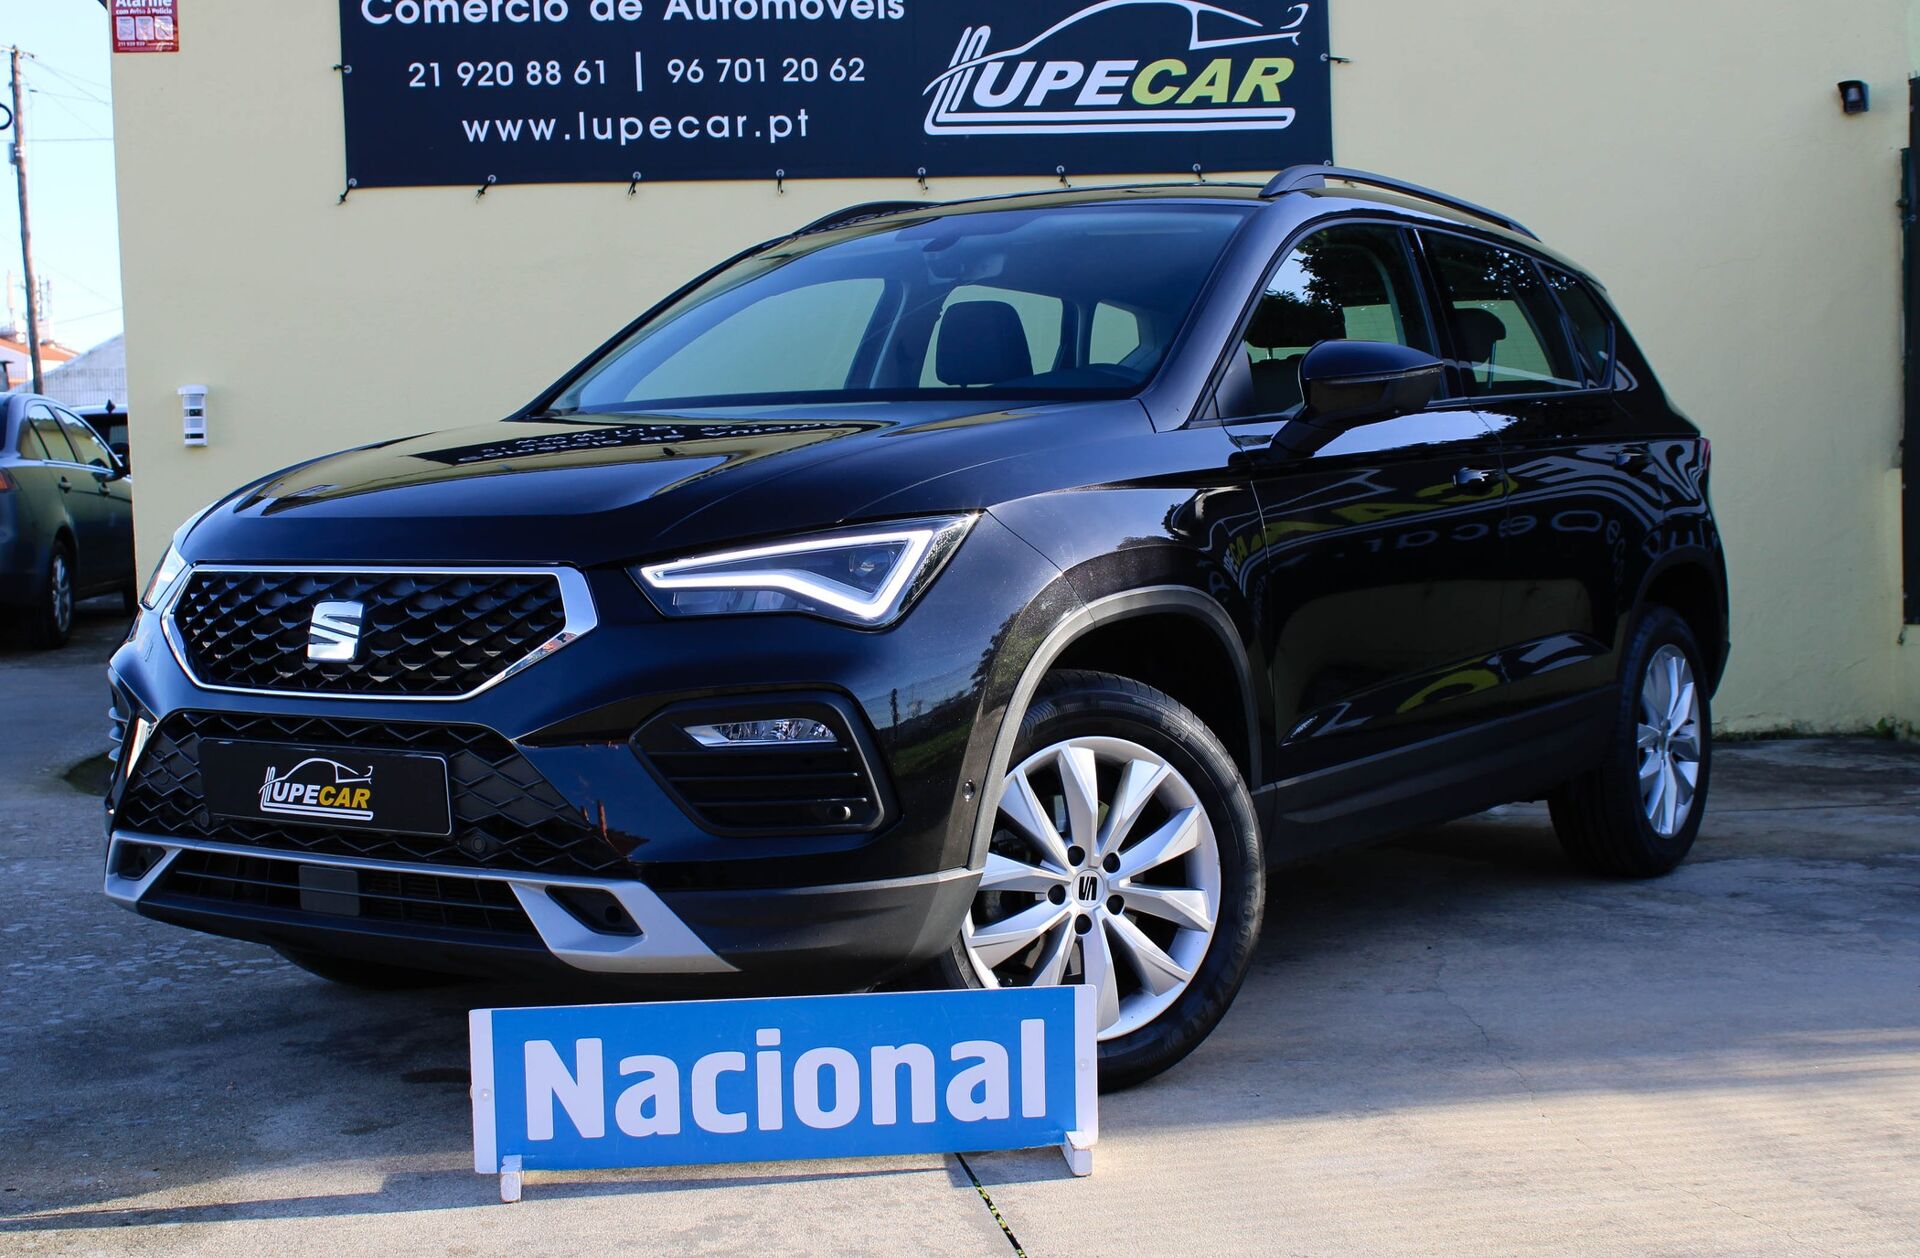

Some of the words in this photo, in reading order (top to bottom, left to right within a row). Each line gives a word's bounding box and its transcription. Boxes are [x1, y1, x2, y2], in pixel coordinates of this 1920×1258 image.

[589, 0, 643, 21] de
[408, 62, 440, 87] 21
[456, 61, 514, 86] 920
[526, 60, 562, 85] 88
[574, 60, 605, 84] 61
[667, 59, 704, 83] 96
[717, 58, 766, 82] 701
[782, 57, 818, 82] 20
[829, 57, 865, 82] 62
[462, 108, 808, 145] www.lupecar.pt
[523, 1018, 1047, 1141] Nacional
